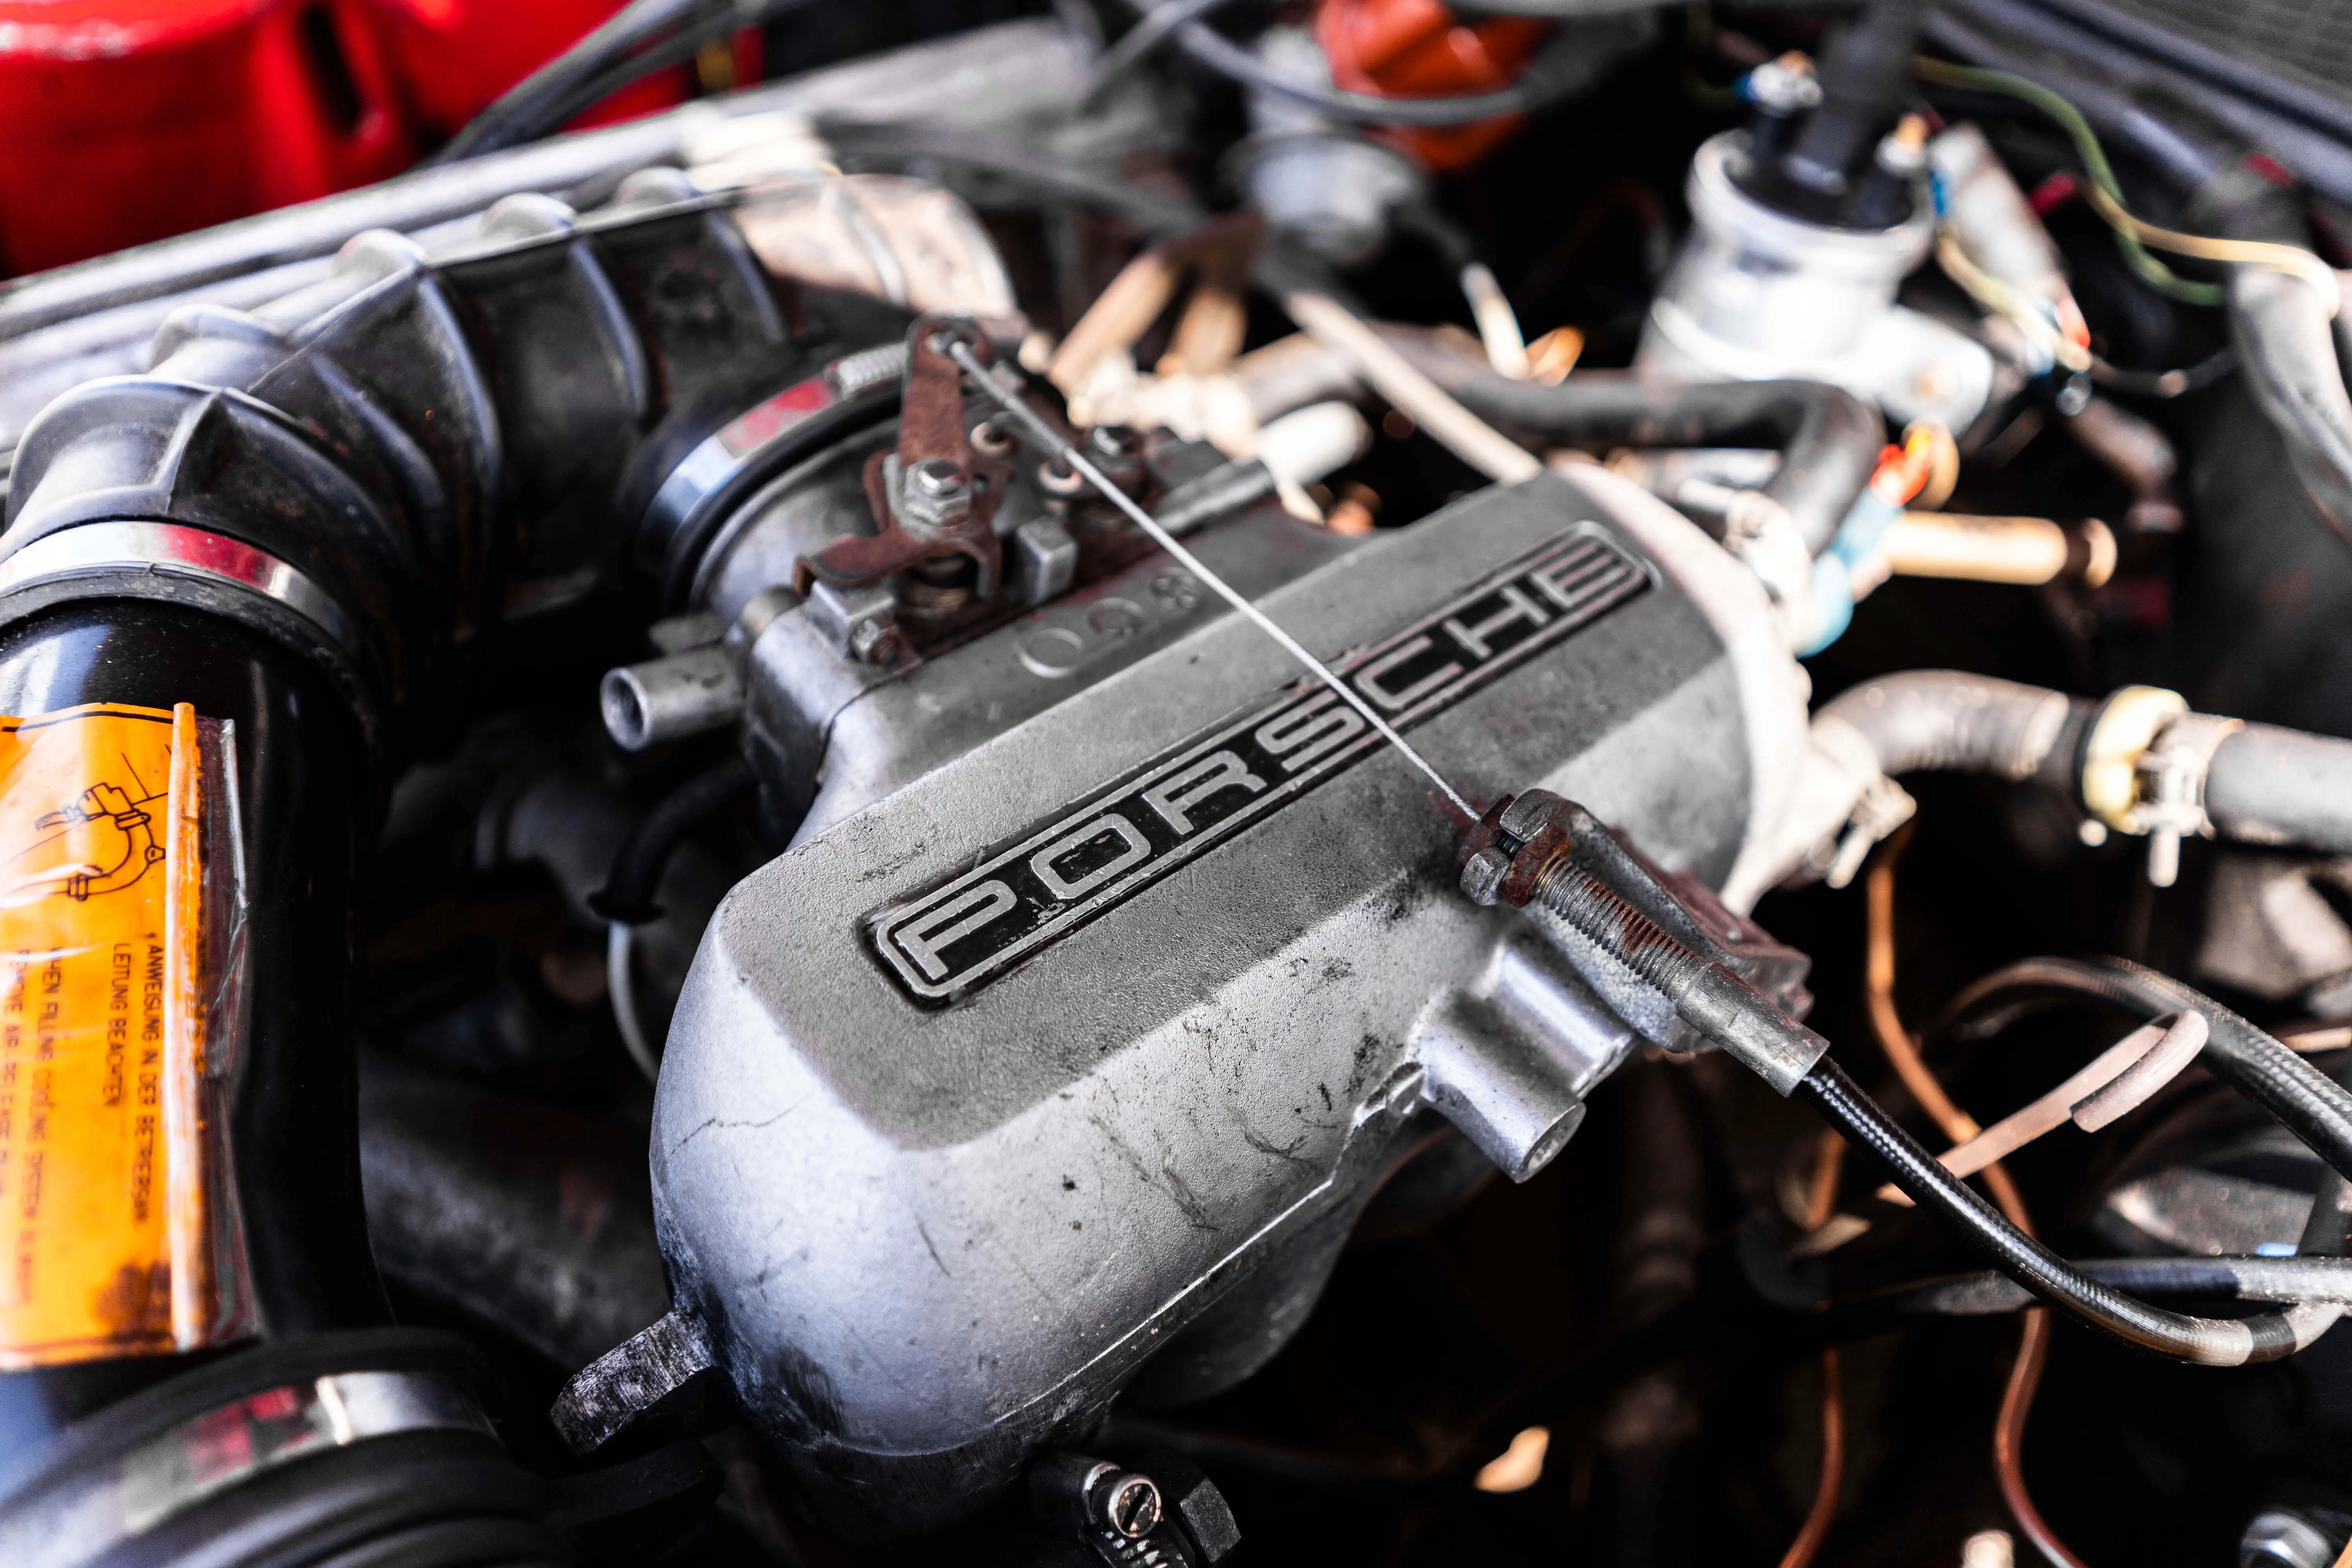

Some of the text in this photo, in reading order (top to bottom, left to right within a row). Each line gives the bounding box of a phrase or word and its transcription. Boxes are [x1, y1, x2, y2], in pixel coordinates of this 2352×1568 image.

[895, 545, 1627, 980] PORSCHE
[109, 943, 131, 1011] LEITUNG
[142, 944, 164, 1041] ANWEISUNG
[138, 1073, 157, 1106] DER
[140, 1049, 158, 1065] IN
